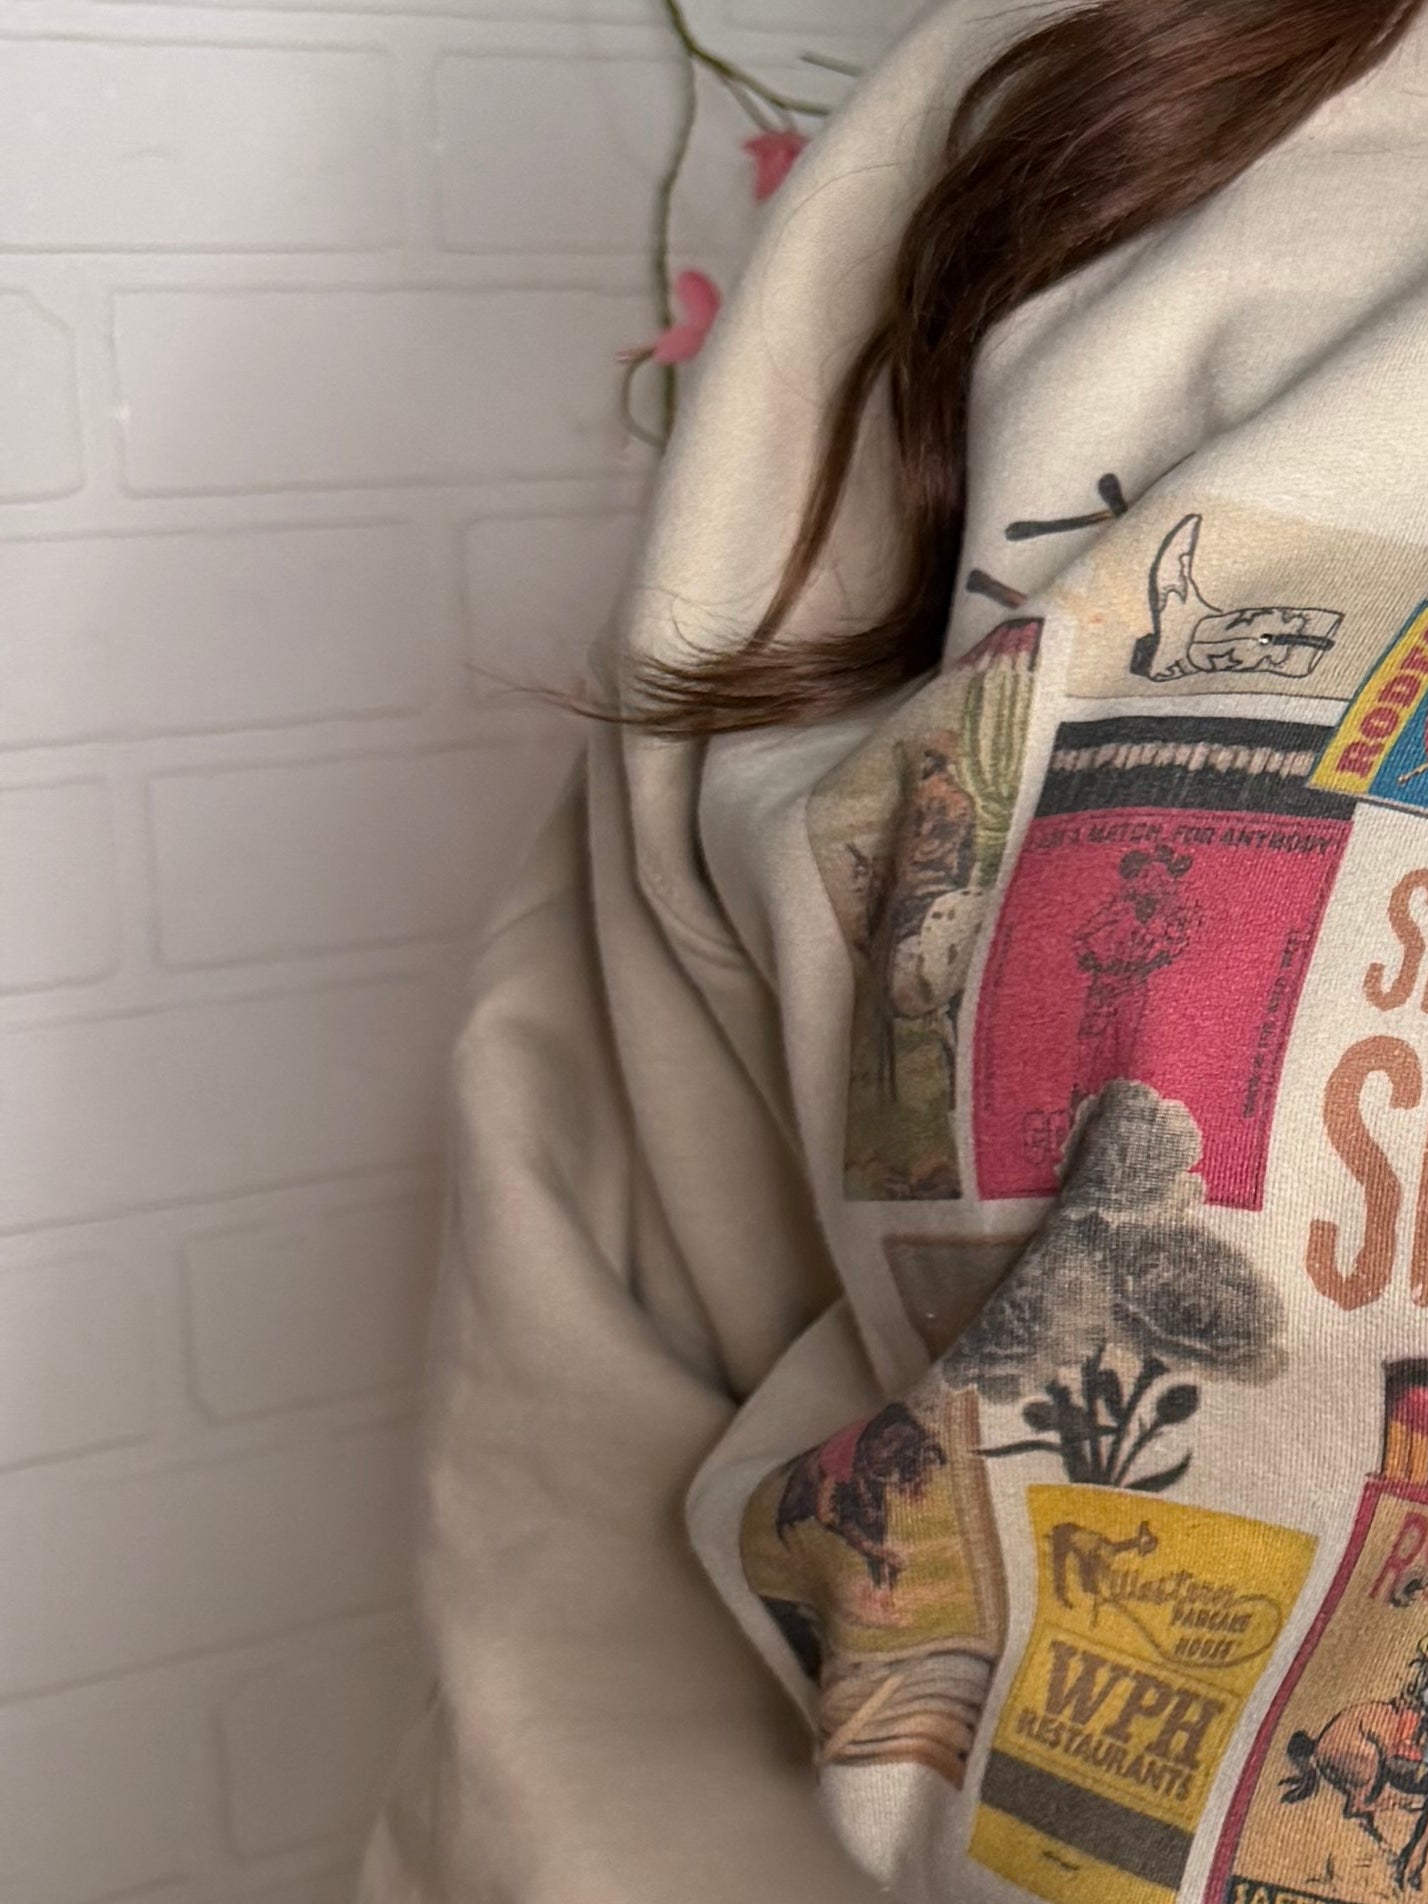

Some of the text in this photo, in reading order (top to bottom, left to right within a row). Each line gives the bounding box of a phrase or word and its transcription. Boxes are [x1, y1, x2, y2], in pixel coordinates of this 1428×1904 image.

[1087, 820, 1161, 845] MATCH
[1173, 823, 1214, 846] FOR
[1218, 826, 1332, 855] ANYBODY
[1047, 1639, 1226, 1772] WPH
[1015, 1706, 1198, 1801] RESTAURANTS
